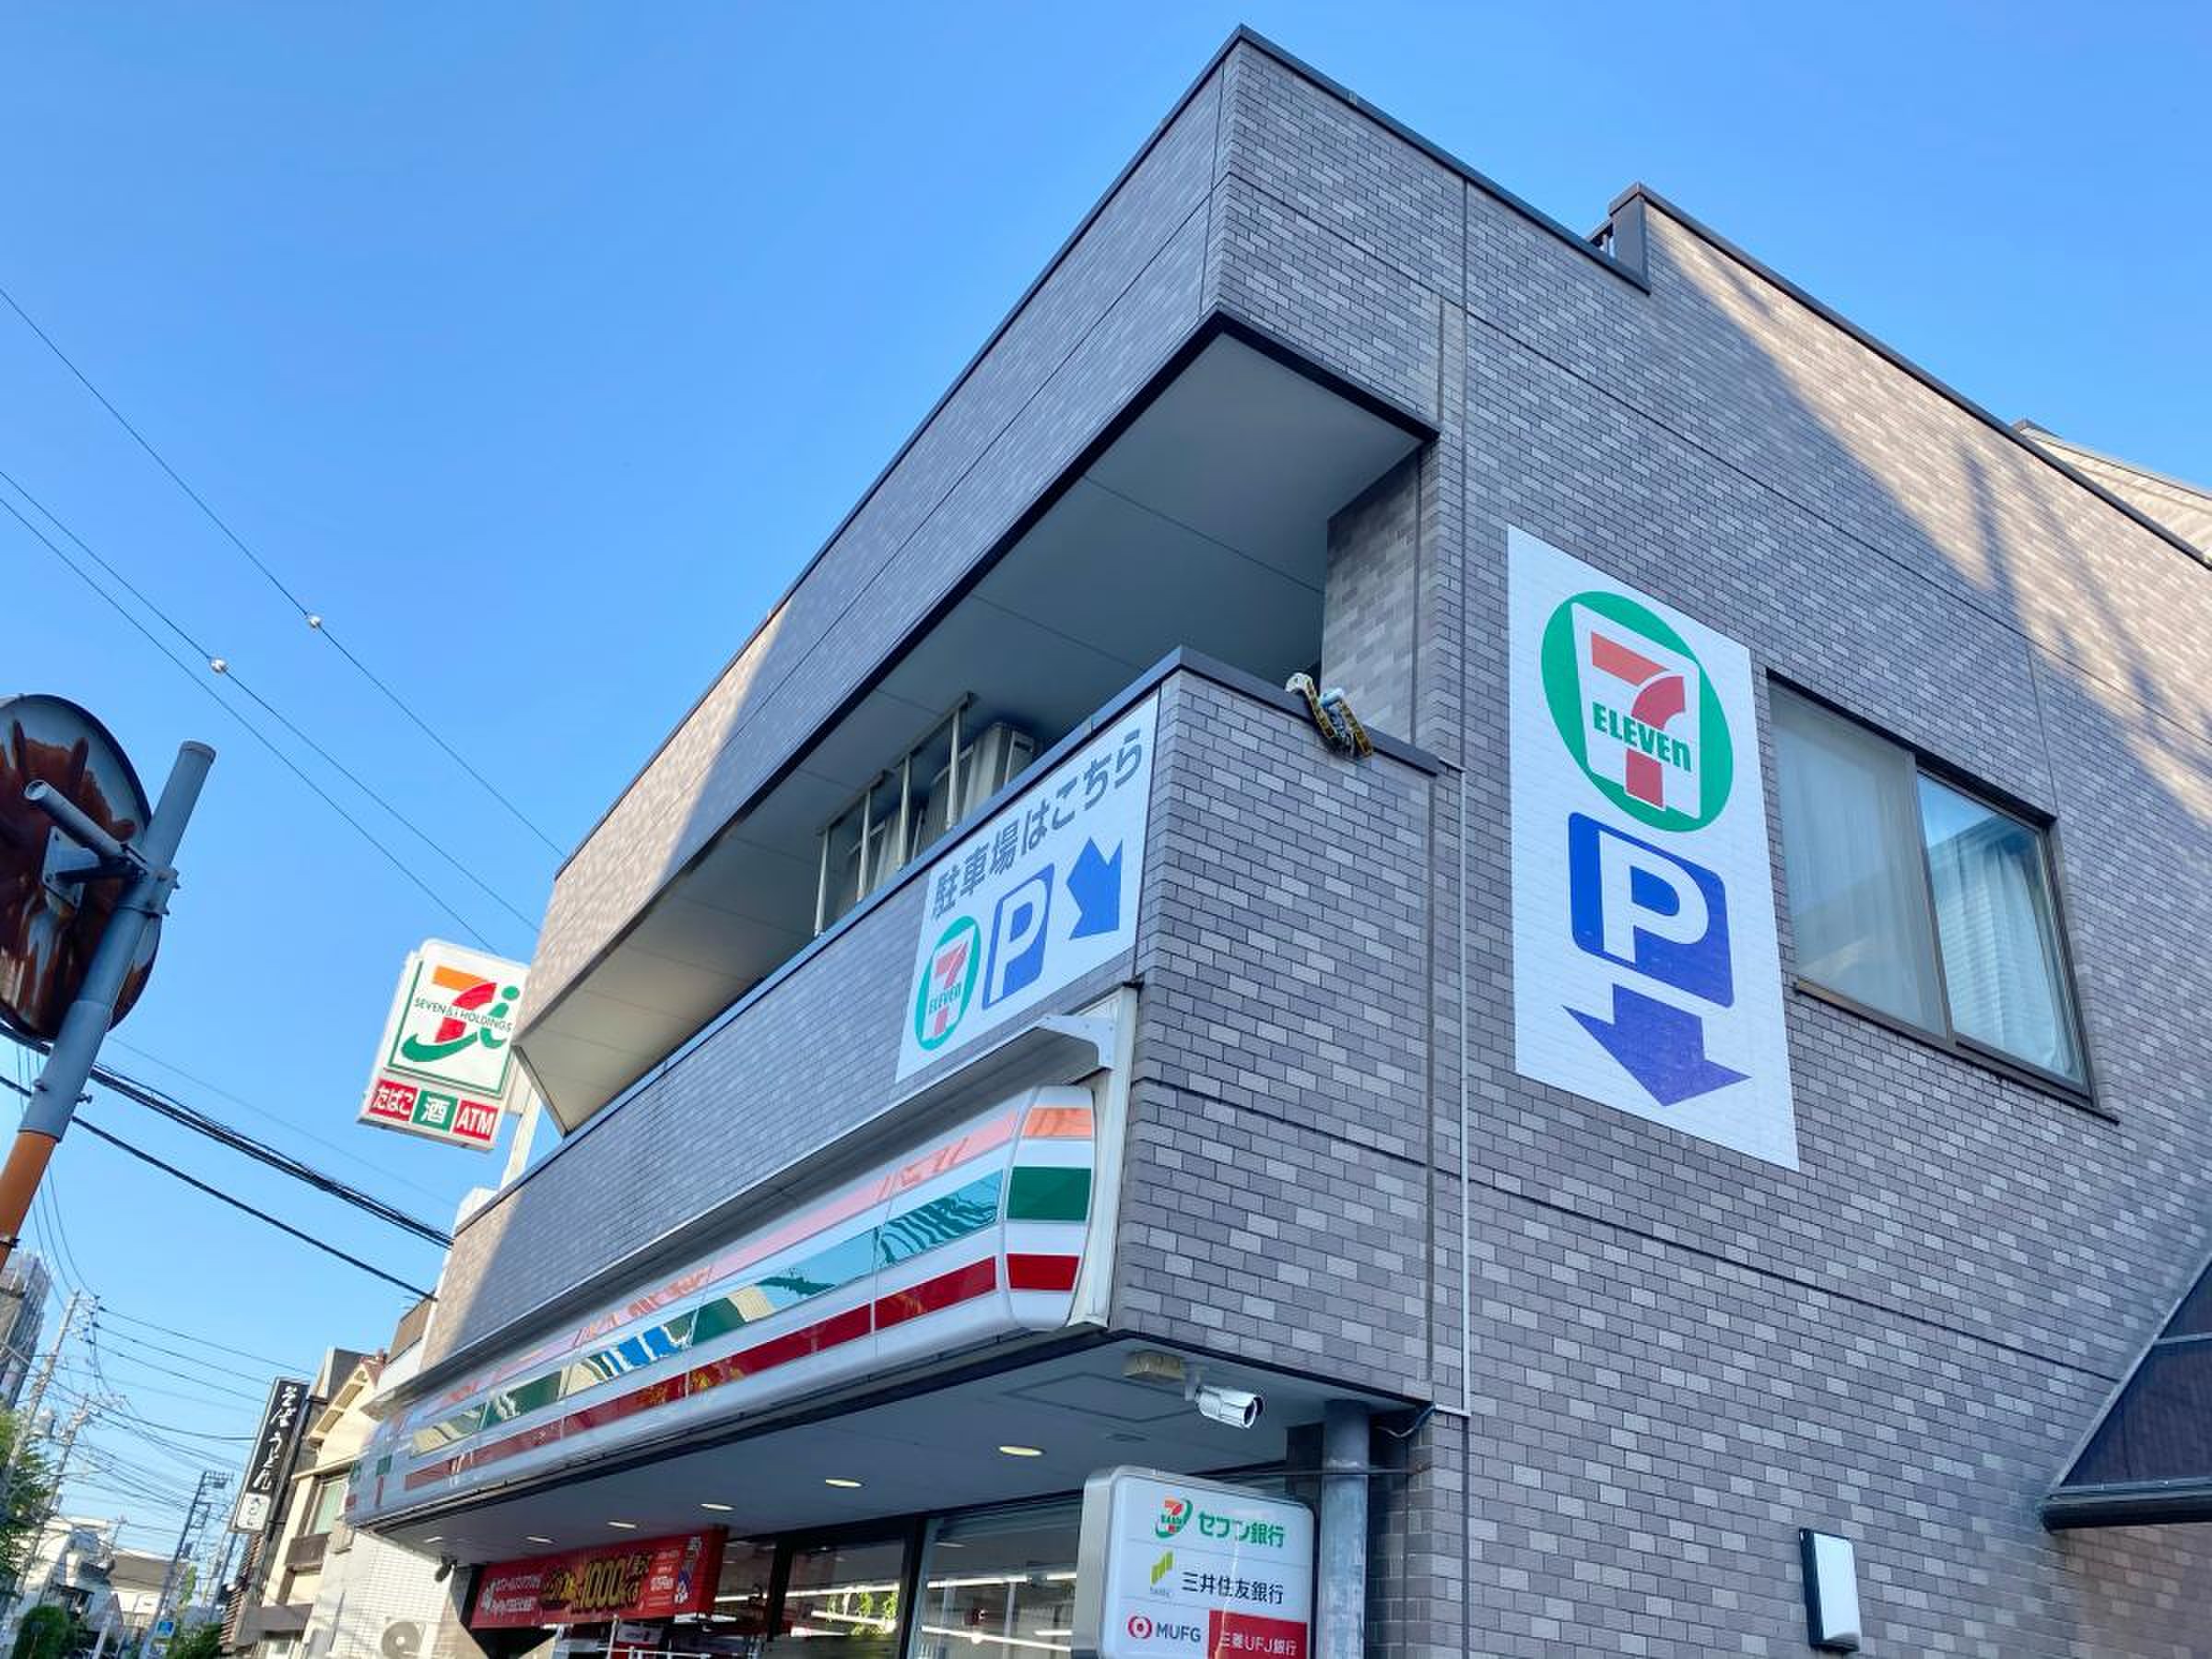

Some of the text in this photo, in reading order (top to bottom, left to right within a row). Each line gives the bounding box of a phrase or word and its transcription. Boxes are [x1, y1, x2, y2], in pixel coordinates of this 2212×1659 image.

[932, 731, 1143, 918] 駐車場はこちら
[1598, 830, 1710, 964] P
[990, 877, 1048, 1005] P
[372, 1087, 414, 1115] たばこ
[420, 1096, 452, 1124] 酒
[456, 1105, 495, 1135] ATM
[1198, 1512, 1284, 1547] セブン銀行
[1181, 1571, 1284, 1605] 三井住友銀行
[1155, 1623, 1201, 1642] MUFG
[1220, 1631, 1297, 1657] 三菱UFJ銀行
